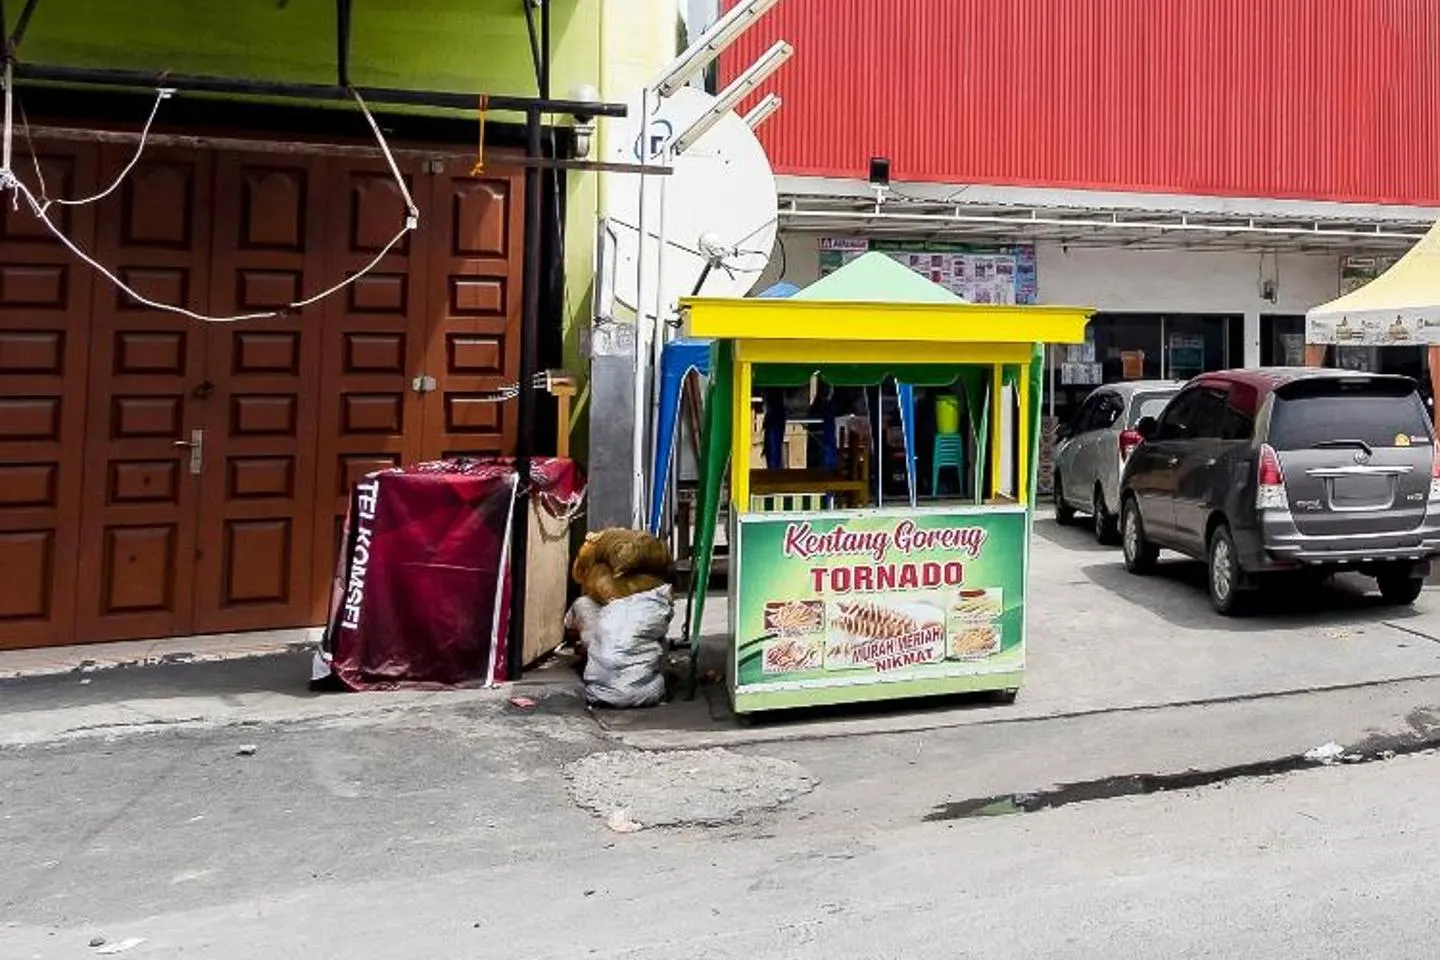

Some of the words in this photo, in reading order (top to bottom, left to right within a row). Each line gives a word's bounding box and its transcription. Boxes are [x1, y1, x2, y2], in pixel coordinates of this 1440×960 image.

[784, 522, 888, 560] Kentang
[893, 520, 984, 555] Goreng
[811, 561, 963, 593] TORNADO
[875, 648, 934, 673] NIKMAT
